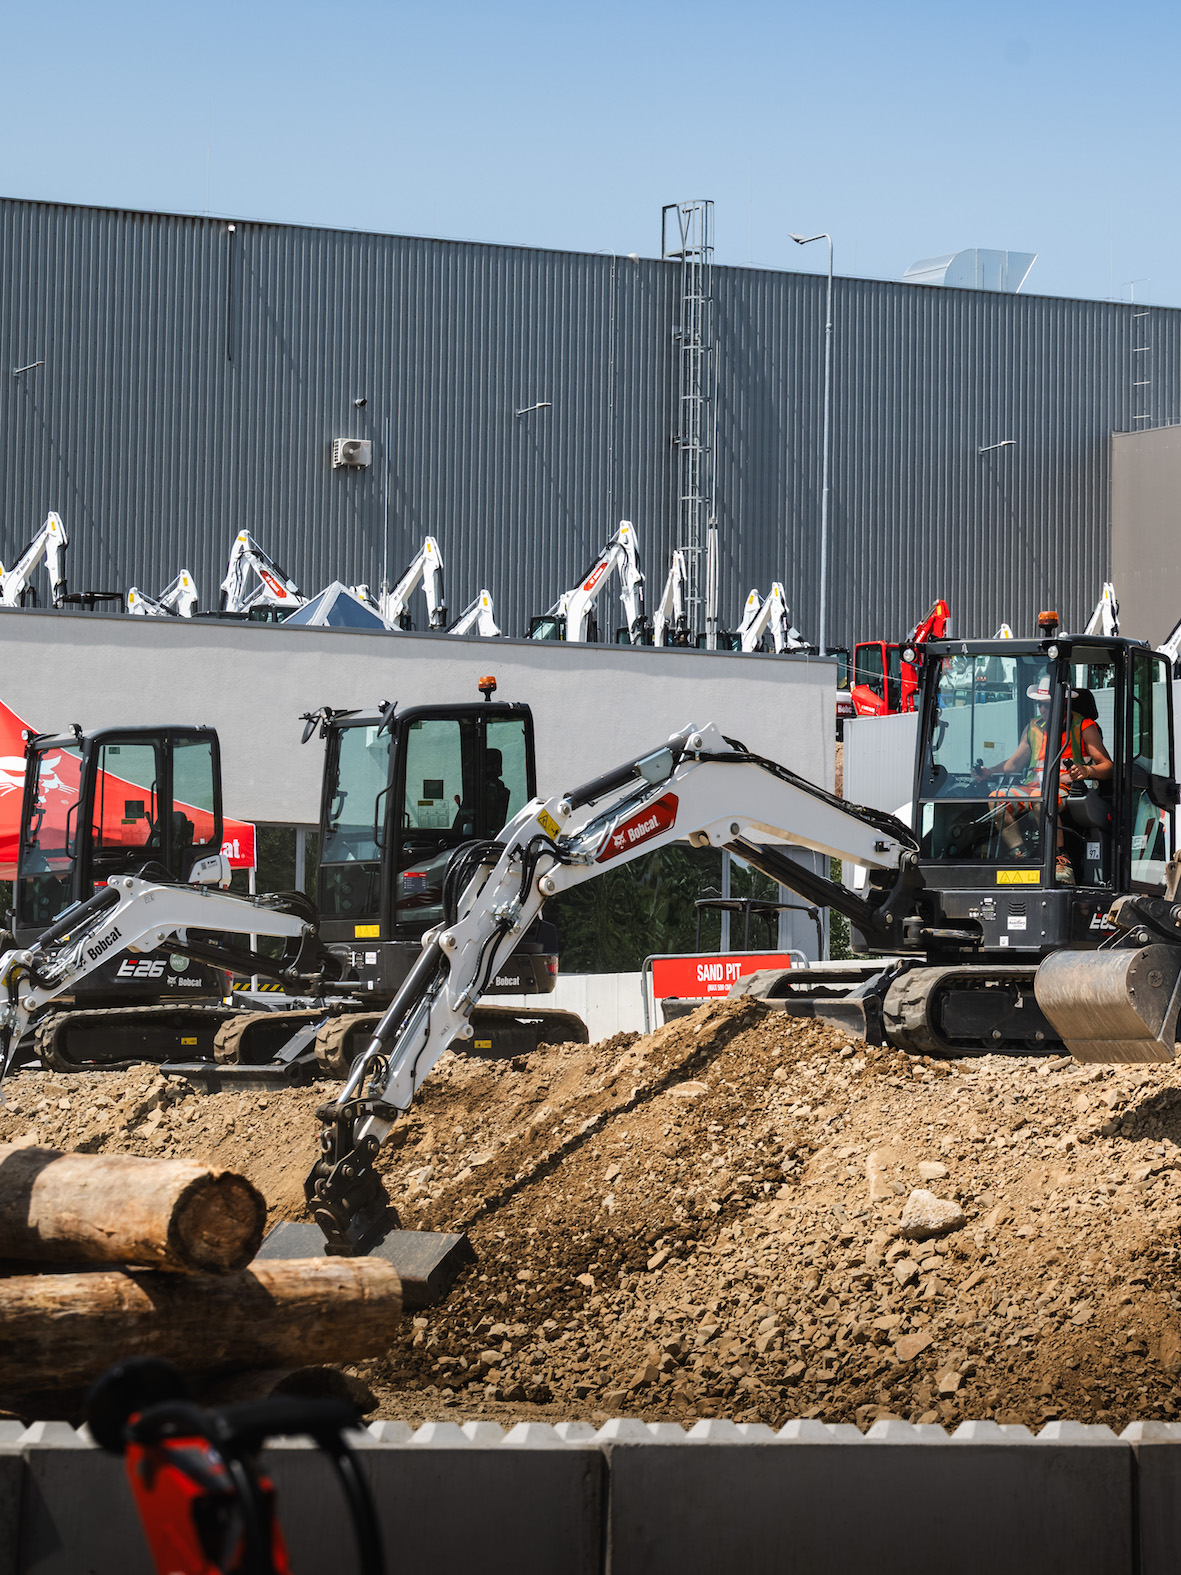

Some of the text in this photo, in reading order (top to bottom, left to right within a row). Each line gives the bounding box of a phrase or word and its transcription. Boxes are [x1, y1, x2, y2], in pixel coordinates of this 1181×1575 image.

[627, 815, 659, 842] Bobcat
[87, 926, 123, 961] Bobcat
[117, 958, 167, 978] E26
[697, 963, 741, 981] SAND PIT
[178, 977, 202, 987] Bobcat
[495, 976, 520, 987] Bobcat
